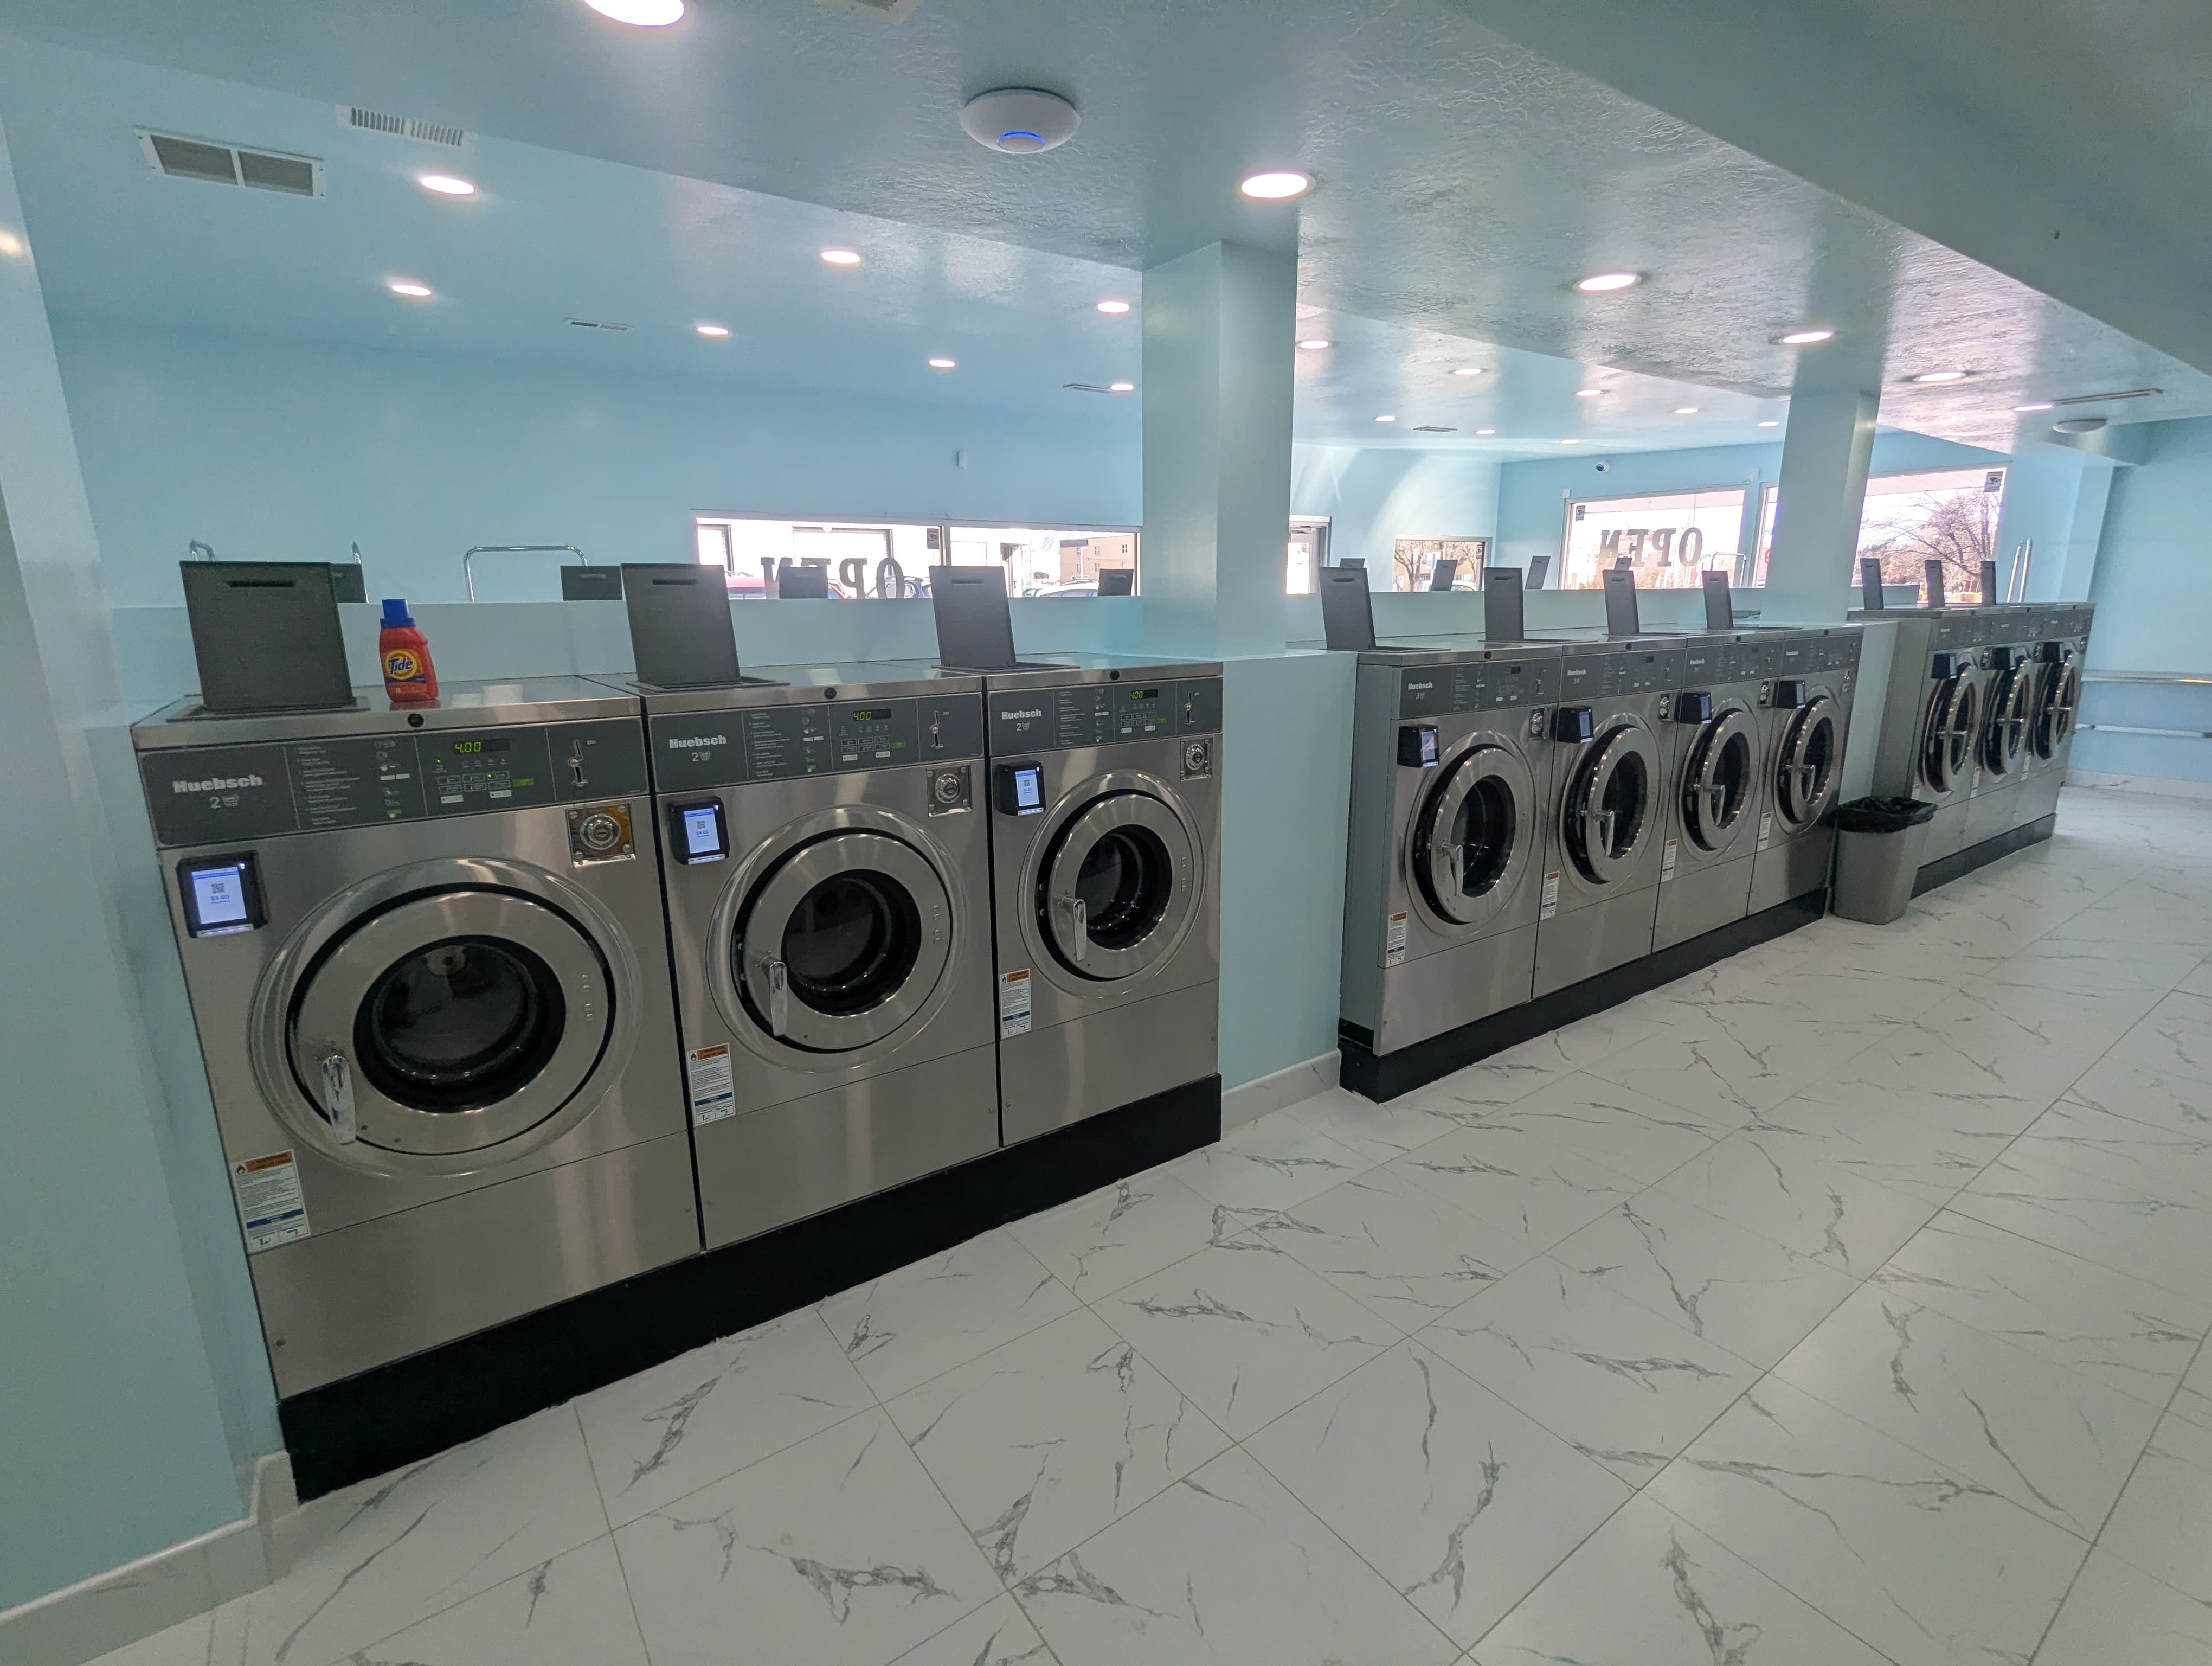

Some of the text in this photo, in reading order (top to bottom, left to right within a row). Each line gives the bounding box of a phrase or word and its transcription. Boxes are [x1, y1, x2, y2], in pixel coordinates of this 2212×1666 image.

[388, 657, 413, 675] Tide
[1001, 709, 1042, 720] Huebsch
[455, 741, 481, 753] 4.00
[668, 735, 727, 749] Huebsch
[172, 774, 263, 793] Huebsch
